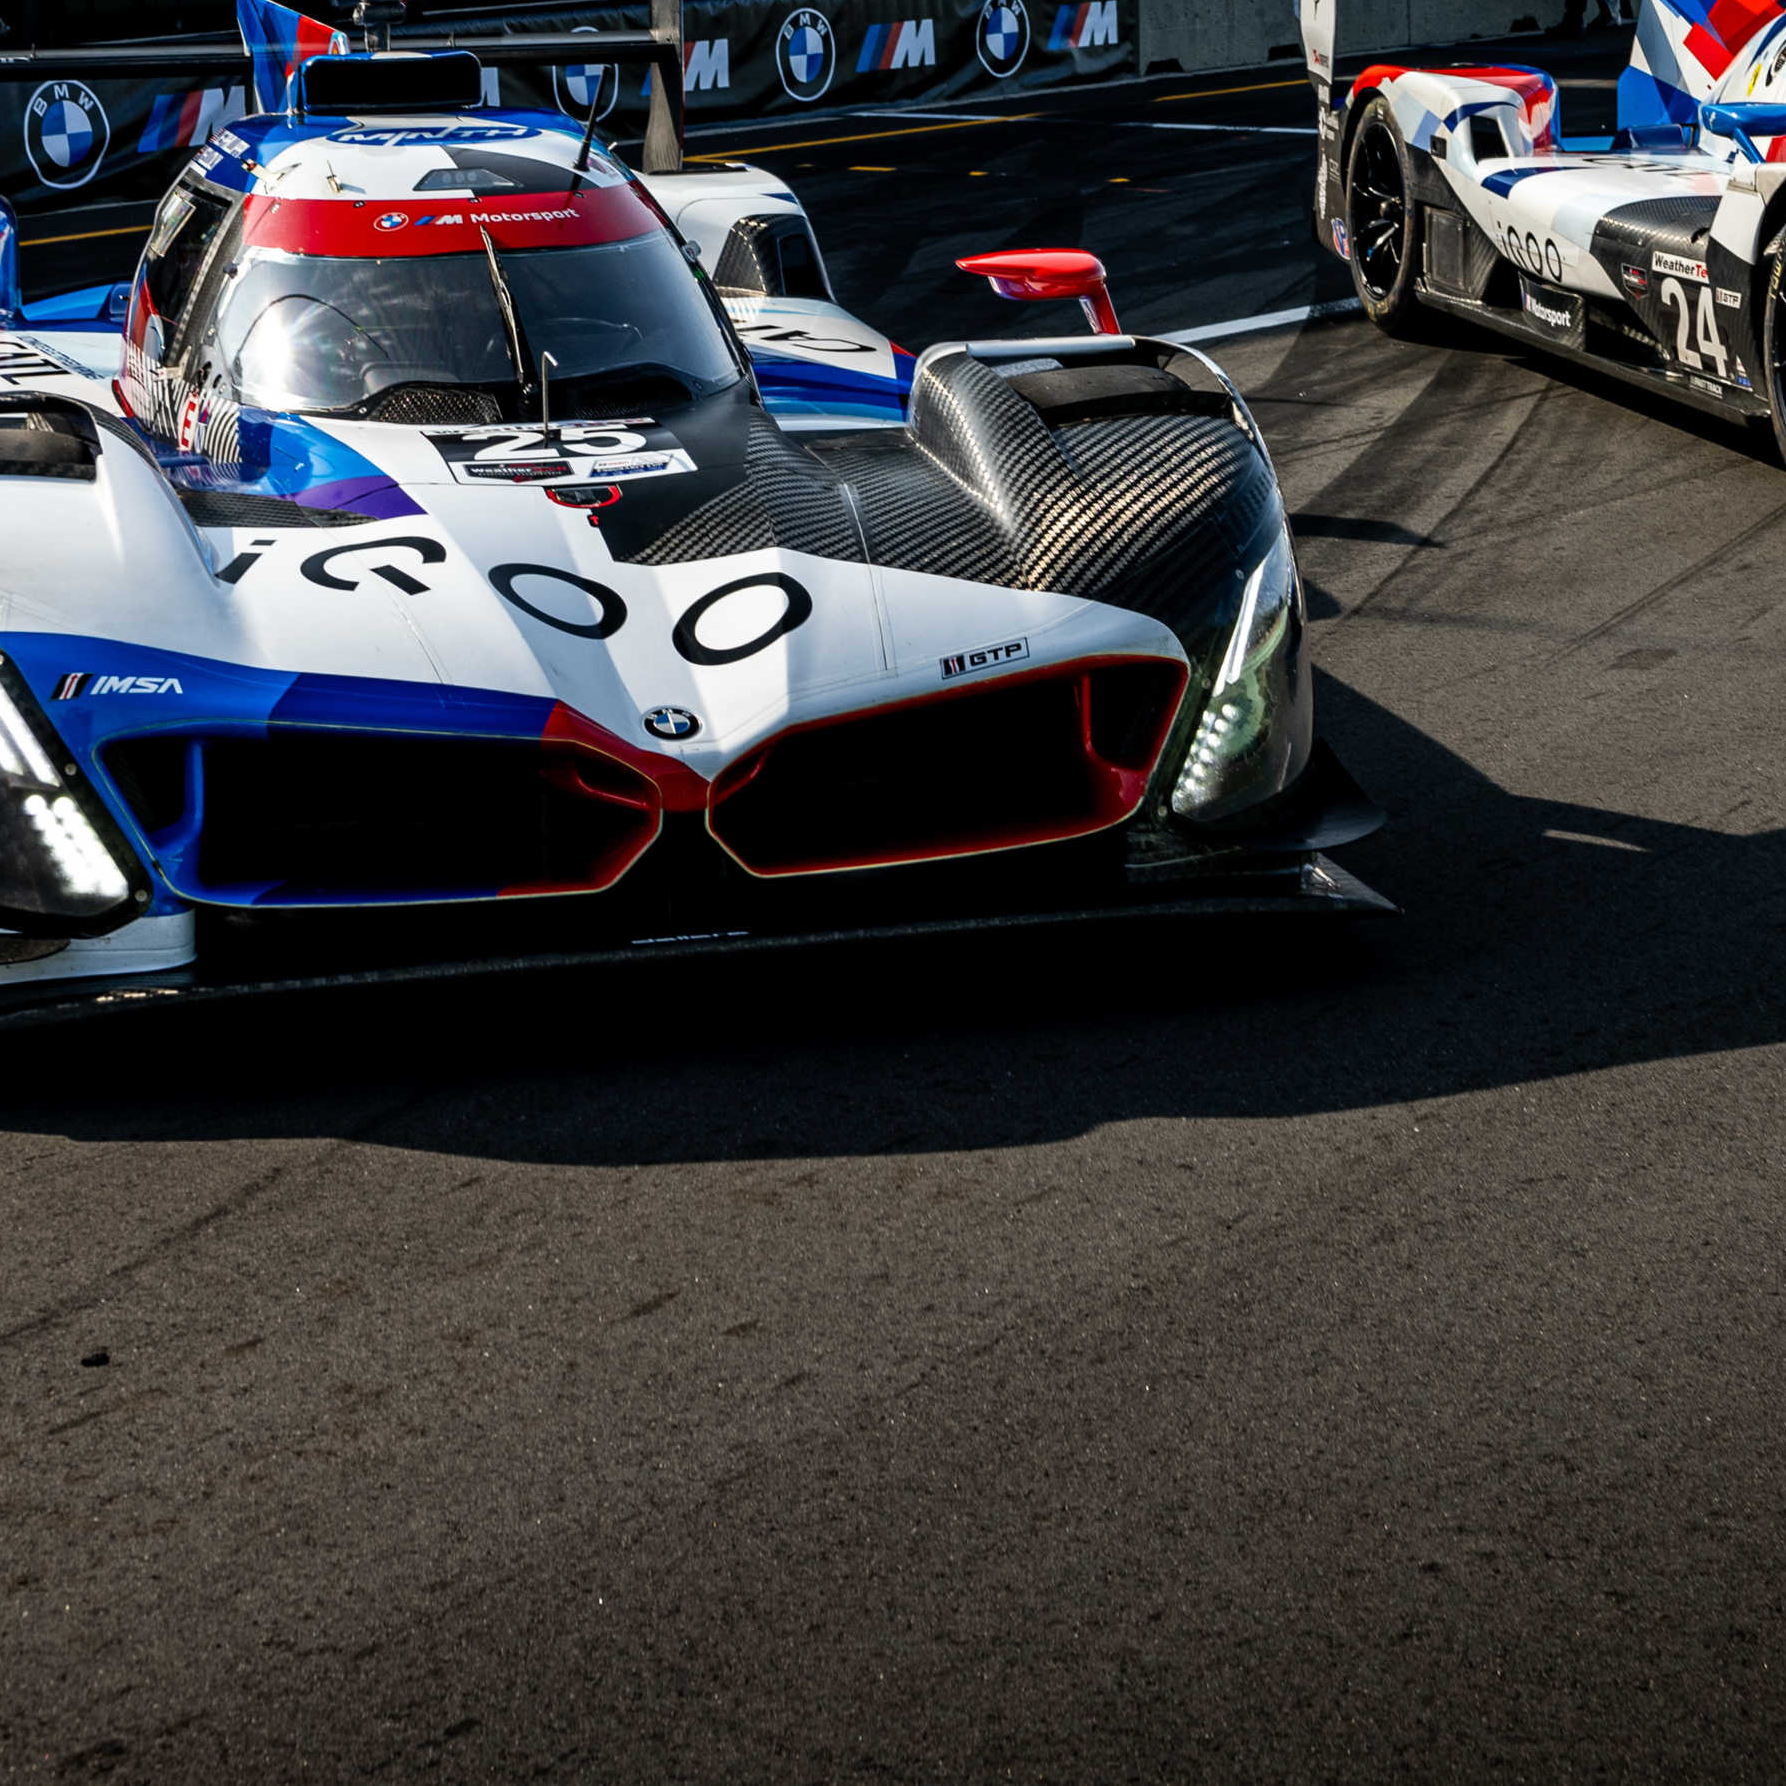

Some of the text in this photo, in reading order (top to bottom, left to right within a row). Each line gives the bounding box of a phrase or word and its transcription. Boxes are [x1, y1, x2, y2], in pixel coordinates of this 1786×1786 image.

[470, 208, 580, 224] Motorsport
[1655, 255, 1708, 278] WeatherTe
[1723, 293, 1739, 305] GTP
[1661, 277, 1728, 377] 24
[462, 425, 647, 461] 25
[969, 643, 1021, 666] GTP
[91, 676, 183, 694] IMSA
